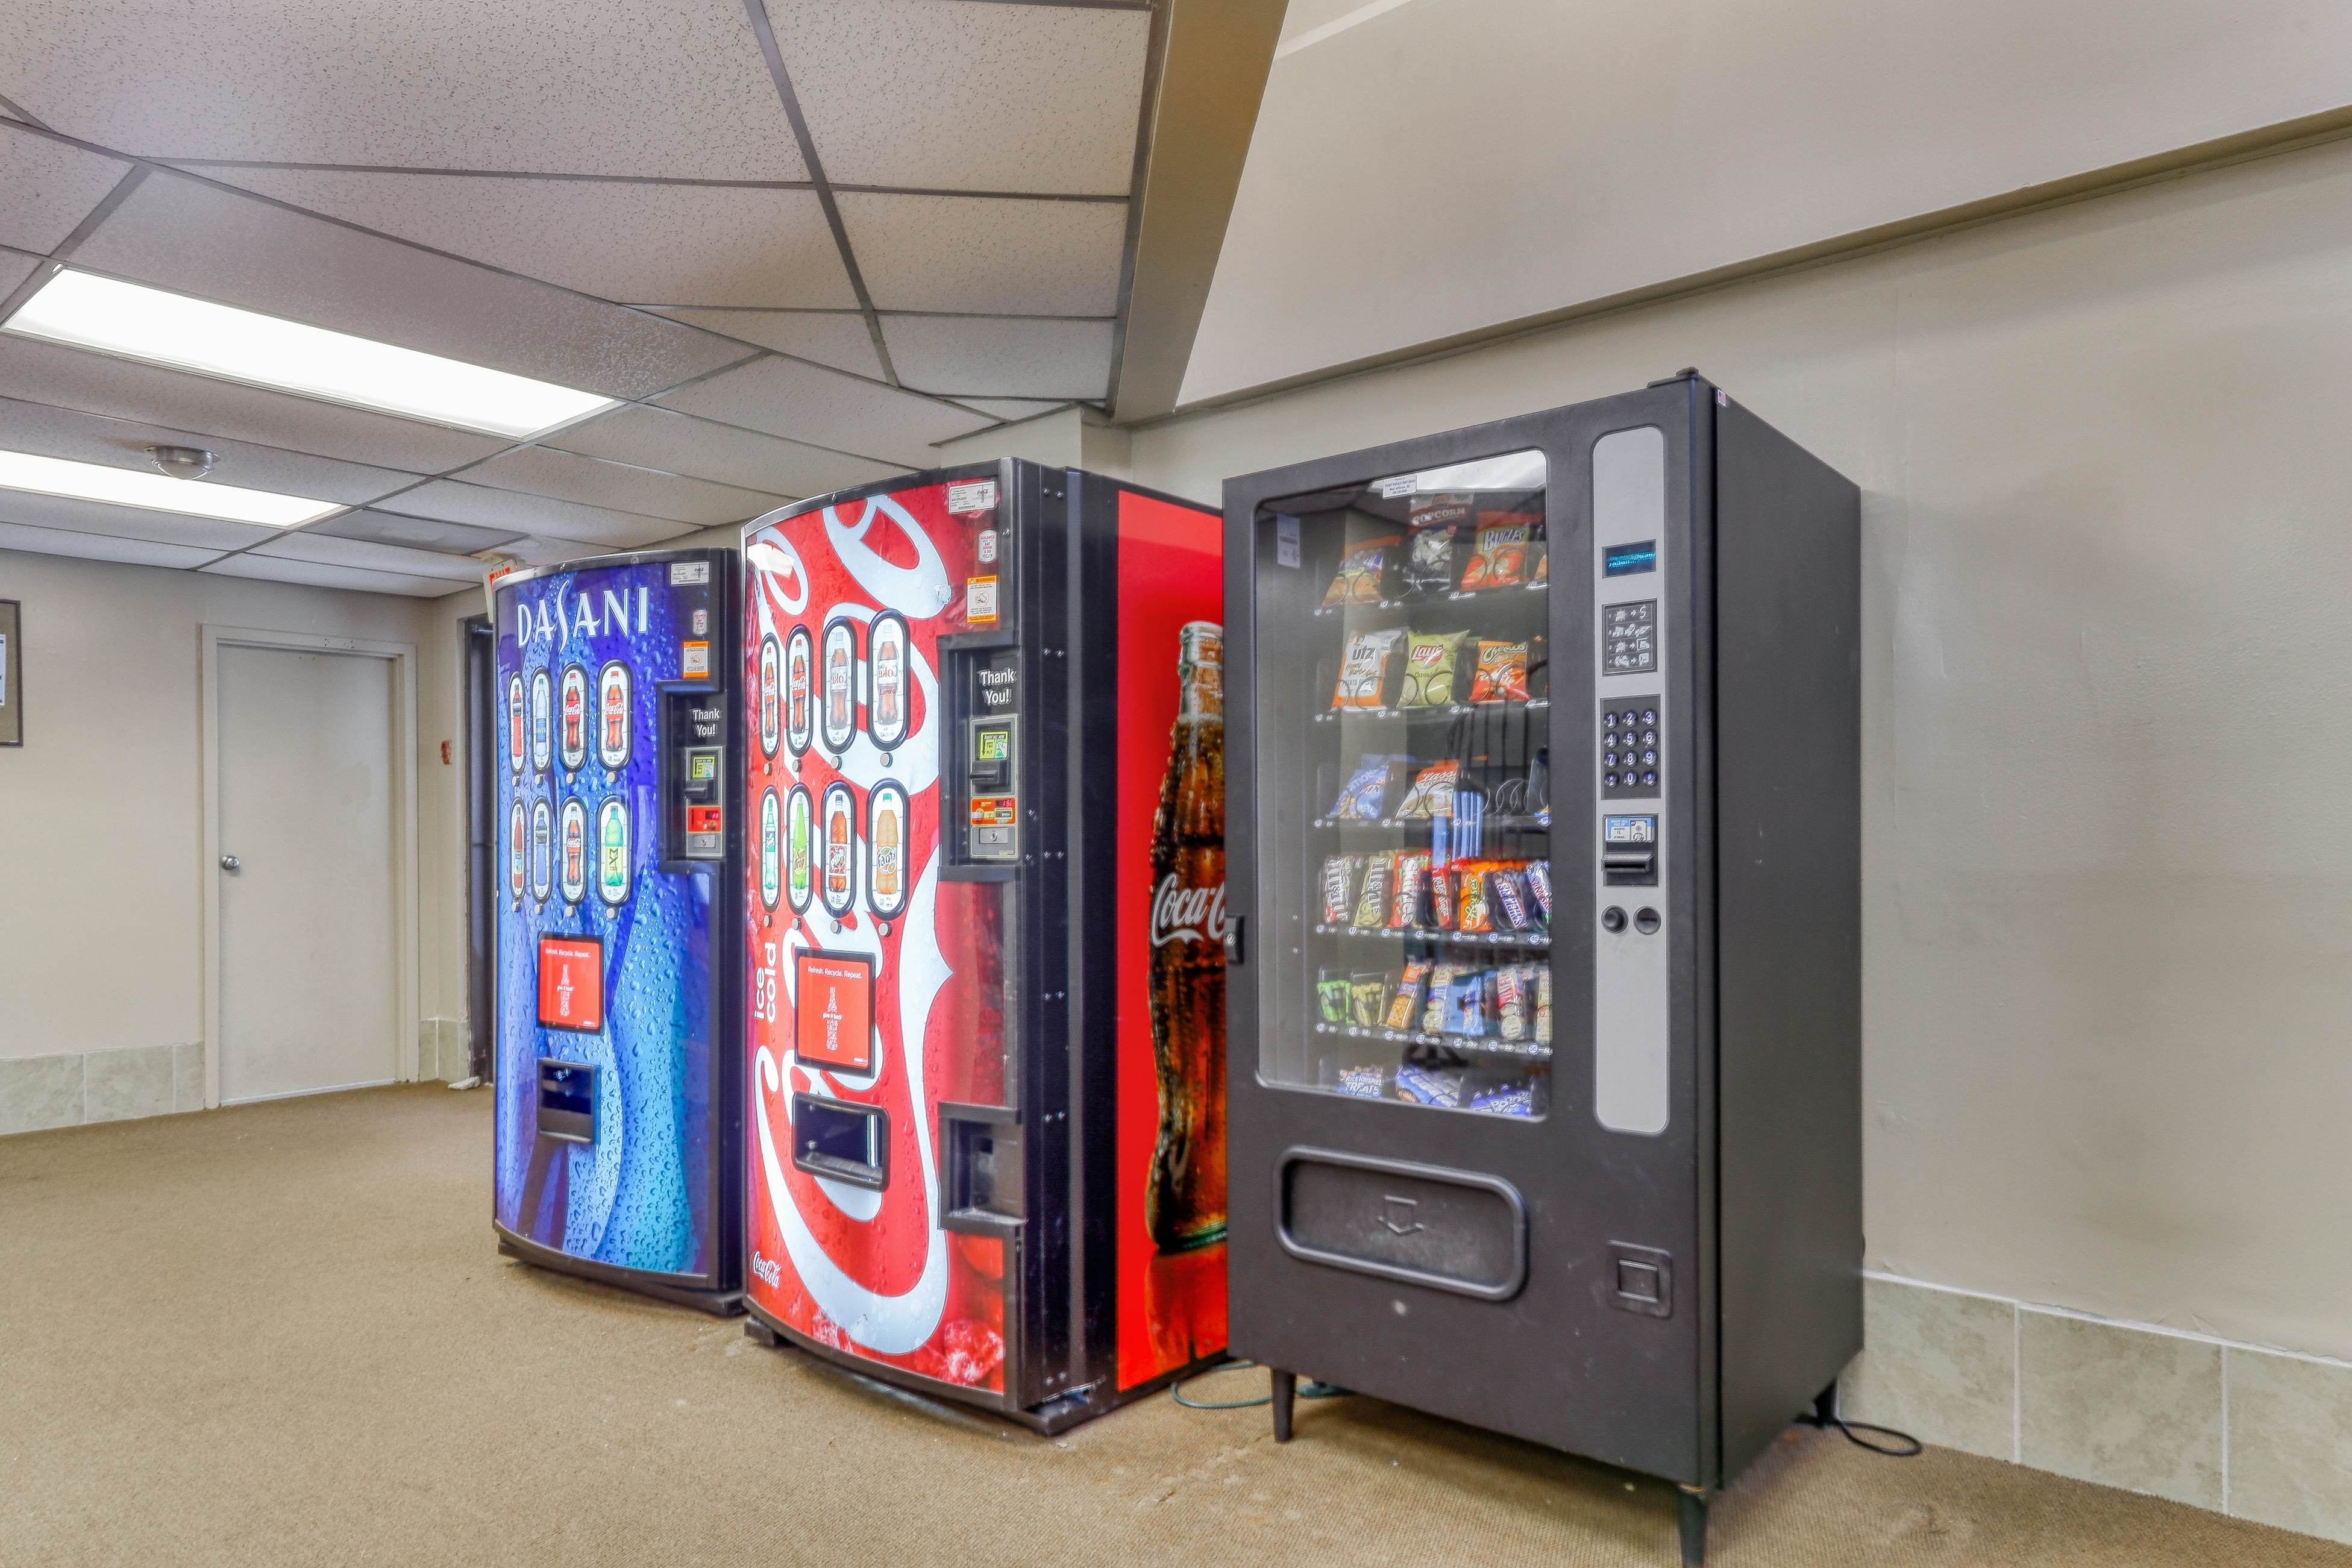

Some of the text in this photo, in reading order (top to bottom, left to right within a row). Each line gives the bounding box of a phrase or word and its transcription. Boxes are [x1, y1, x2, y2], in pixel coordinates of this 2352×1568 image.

[1411, 507, 1466, 525] POPCORN
[517, 580, 649, 653] DASANI
[980, 668, 1015, 685] Thank
[985, 689, 1009, 704] You!
[692, 707, 720, 721] Thank
[1607, 711, 1652, 725] 1 2 3
[696, 724, 716, 736] You!
[1607, 732, 1652, 744] 4 5 6
[1608, 753, 1652, 764] 7 8 9
[1627, 773, 1633, 782] 0
[877, 850, 896, 868] Fanta
[1401, 858, 1418, 924] Skittles
[1151, 873, 1225, 949] Coca-C
[1497, 882, 1528, 930] SNICKERS
[808, 966, 863, 979] Refresh. Recycle. Repeat.
[764, 942, 777, 1023] cold
[754, 967, 765, 1020] ice
[1345, 1081, 1380, 1095] TREATS
[752, 1250, 782, 1288] Coca-Cola
